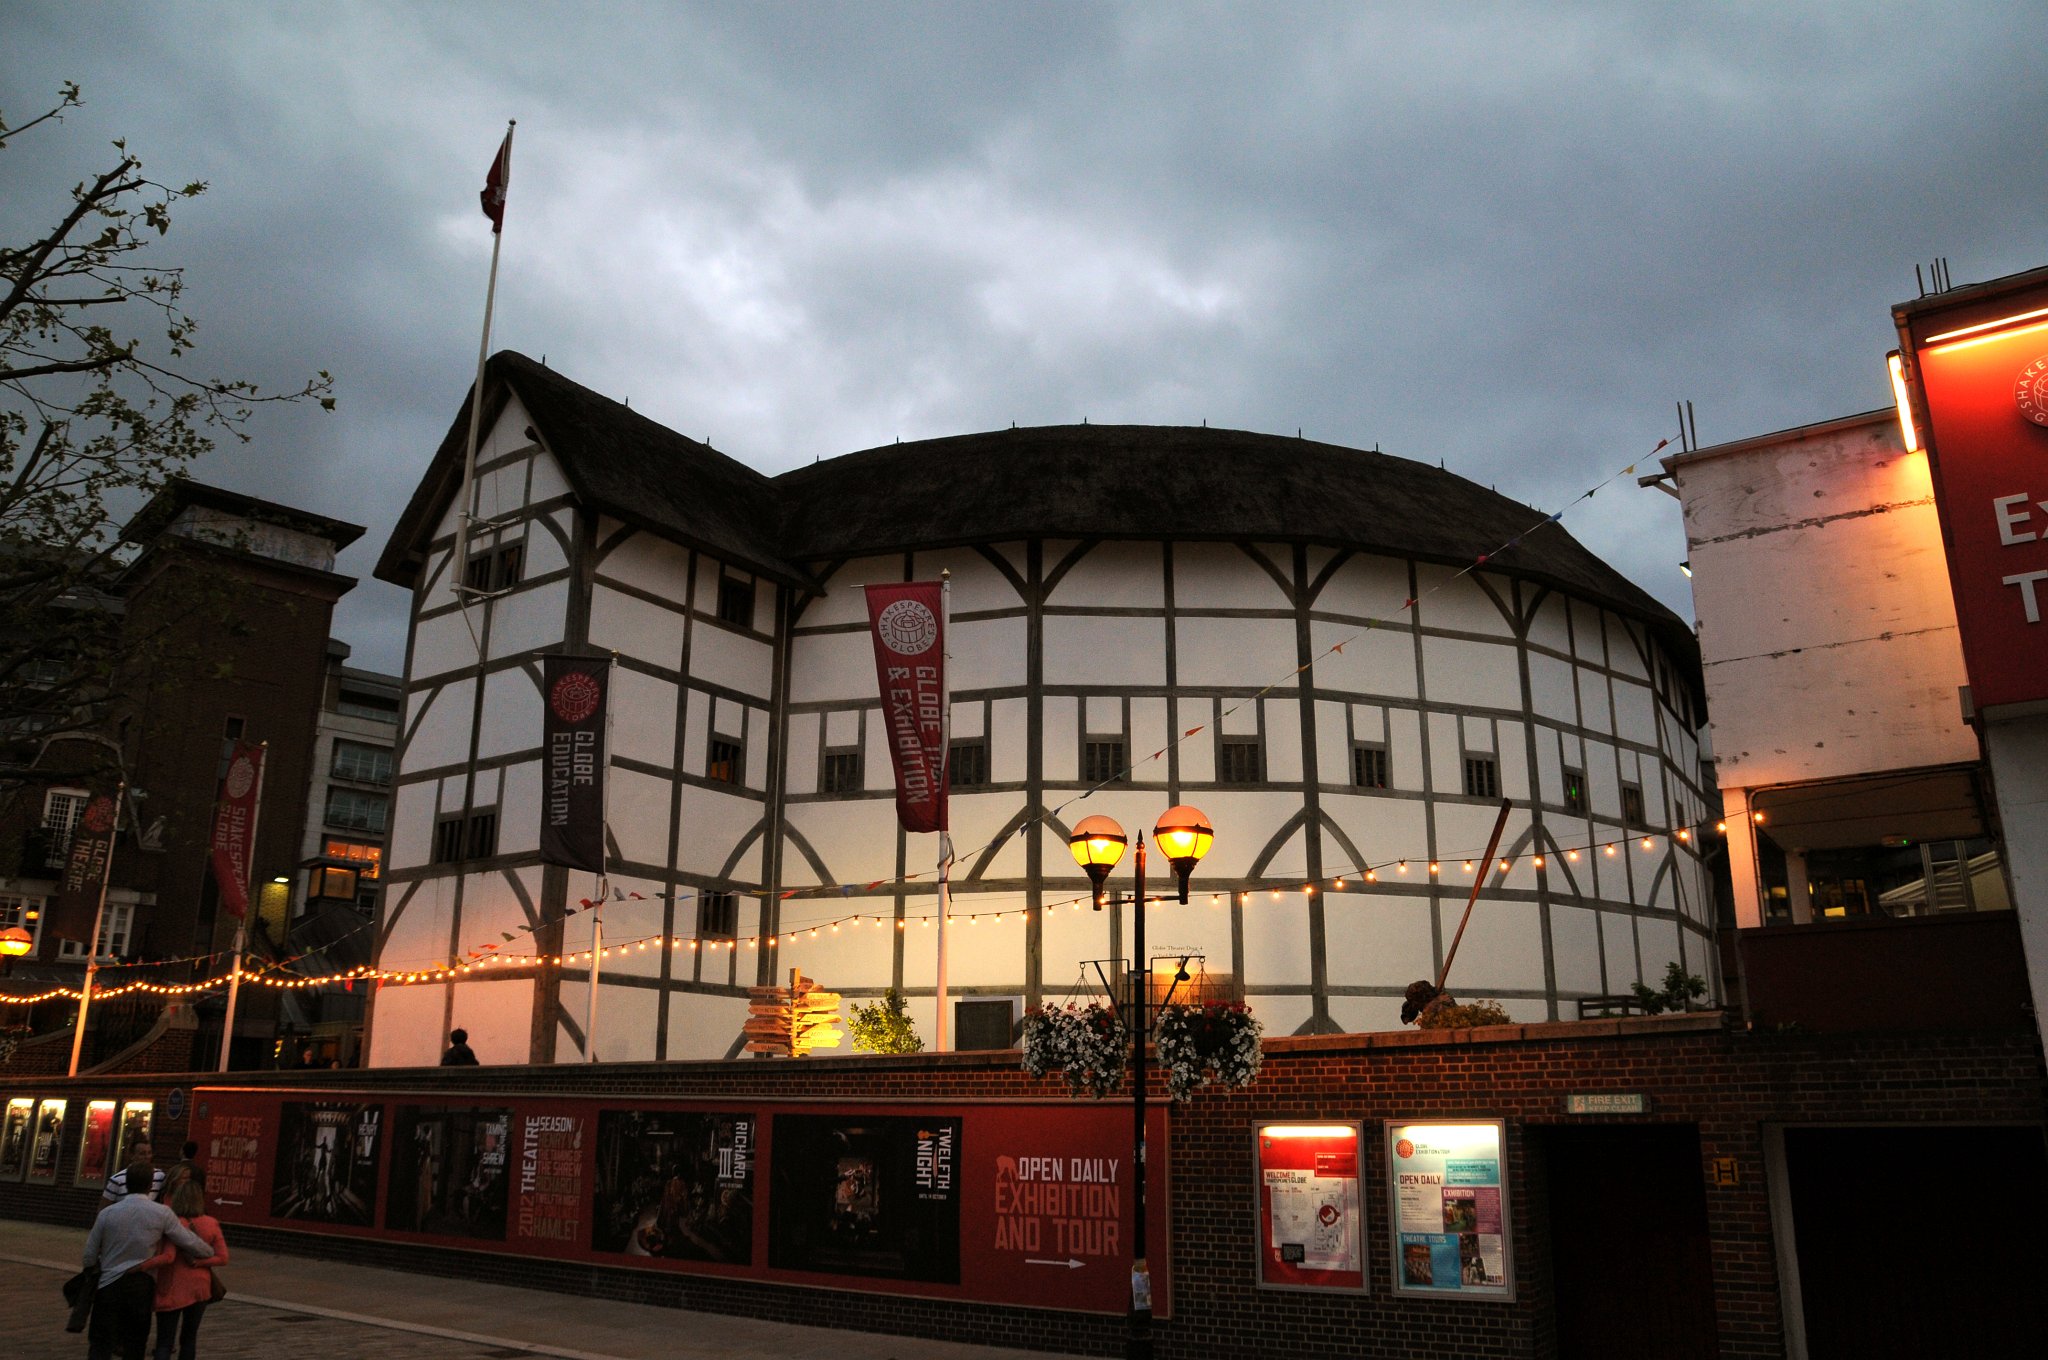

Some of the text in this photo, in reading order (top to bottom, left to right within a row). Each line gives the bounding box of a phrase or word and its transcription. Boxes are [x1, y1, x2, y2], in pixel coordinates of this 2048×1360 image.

[891, 639, 929, 653] GLOBE
[916, 666, 942, 733] GLOBE
[887, 667, 930, 805] & EXHIBITION
[573, 731, 595, 787] GLOBE
[550, 732, 572, 827] EDUCATION
[1588, 1095, 1638, 1104] FIRE EXIT
[212, 1116, 262, 1137] BOX OFFICE
[221, 1137, 249, 1159] SHOP
[734, 1121, 748, 1180] RICHARD
[937, 1126, 953, 1190] TWELFTH
[518, 1116, 539, 1238] 2012 THEATRE
[916, 1139, 935, 1189] NIGHT
[1018, 1157, 1119, 1183] OPEN DAILY
[1266, 1171, 1290, 1179] WELCOME
[1717, 1161, 1736, 1182] H
[205, 1175, 257, 1196] RESTAURANT
[1400, 1175, 1441, 1185] OPEN DAILY
[995, 1181, 1120, 1218] EXHIBITION
[1443, 1189, 1475, 1198] EXHIBITION
[533, 1217, 579, 1240] HAMLET
[995, 1216, 1120, 1256] AND TOUR
